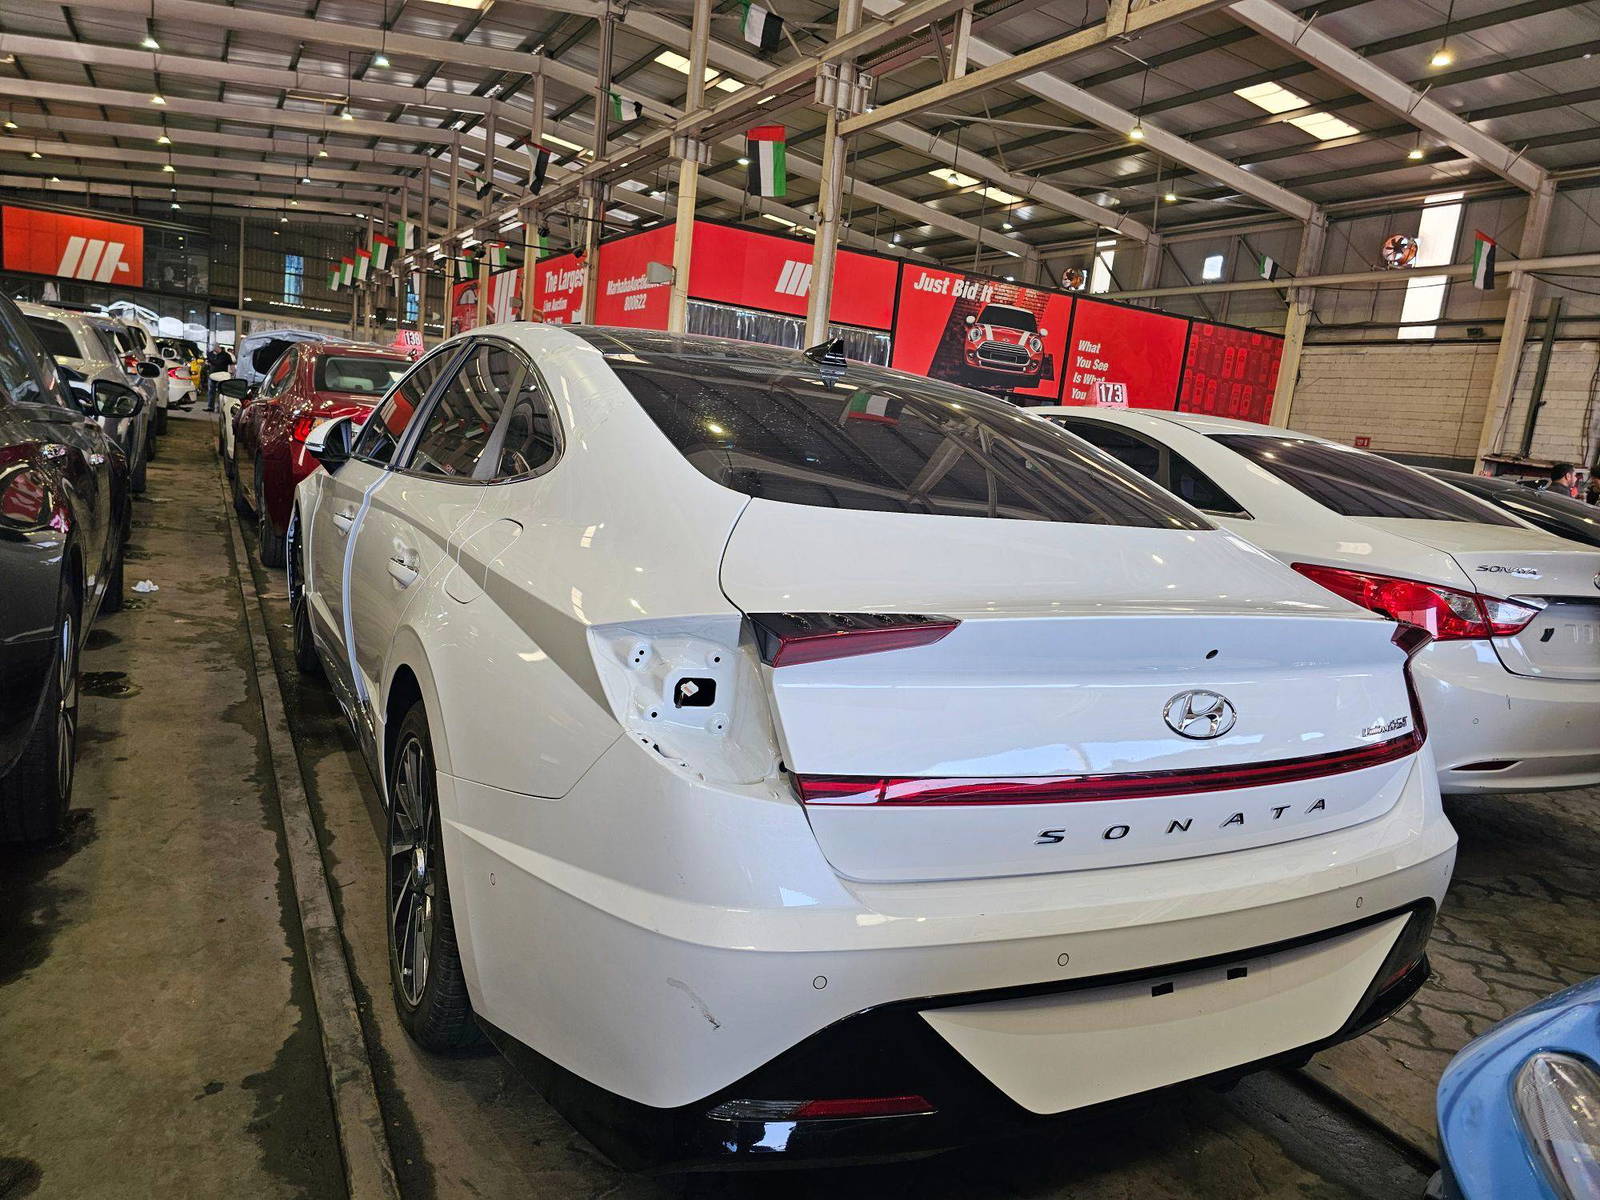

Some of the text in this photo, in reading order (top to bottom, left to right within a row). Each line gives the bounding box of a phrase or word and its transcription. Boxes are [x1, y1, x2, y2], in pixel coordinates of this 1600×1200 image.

[545, 268, 585, 294] The Larges
[913, 272, 994, 303] Just Bid It
[405, 331, 422, 346] 138
[1078, 339, 1102, 354] What
[1076, 355, 1109, 372] You See
[1072, 371, 1083, 384] Is
[1071, 387, 1088, 400] You
[1099, 384, 1124, 402] 173
[1034, 797, 1327, 847] SONATA
